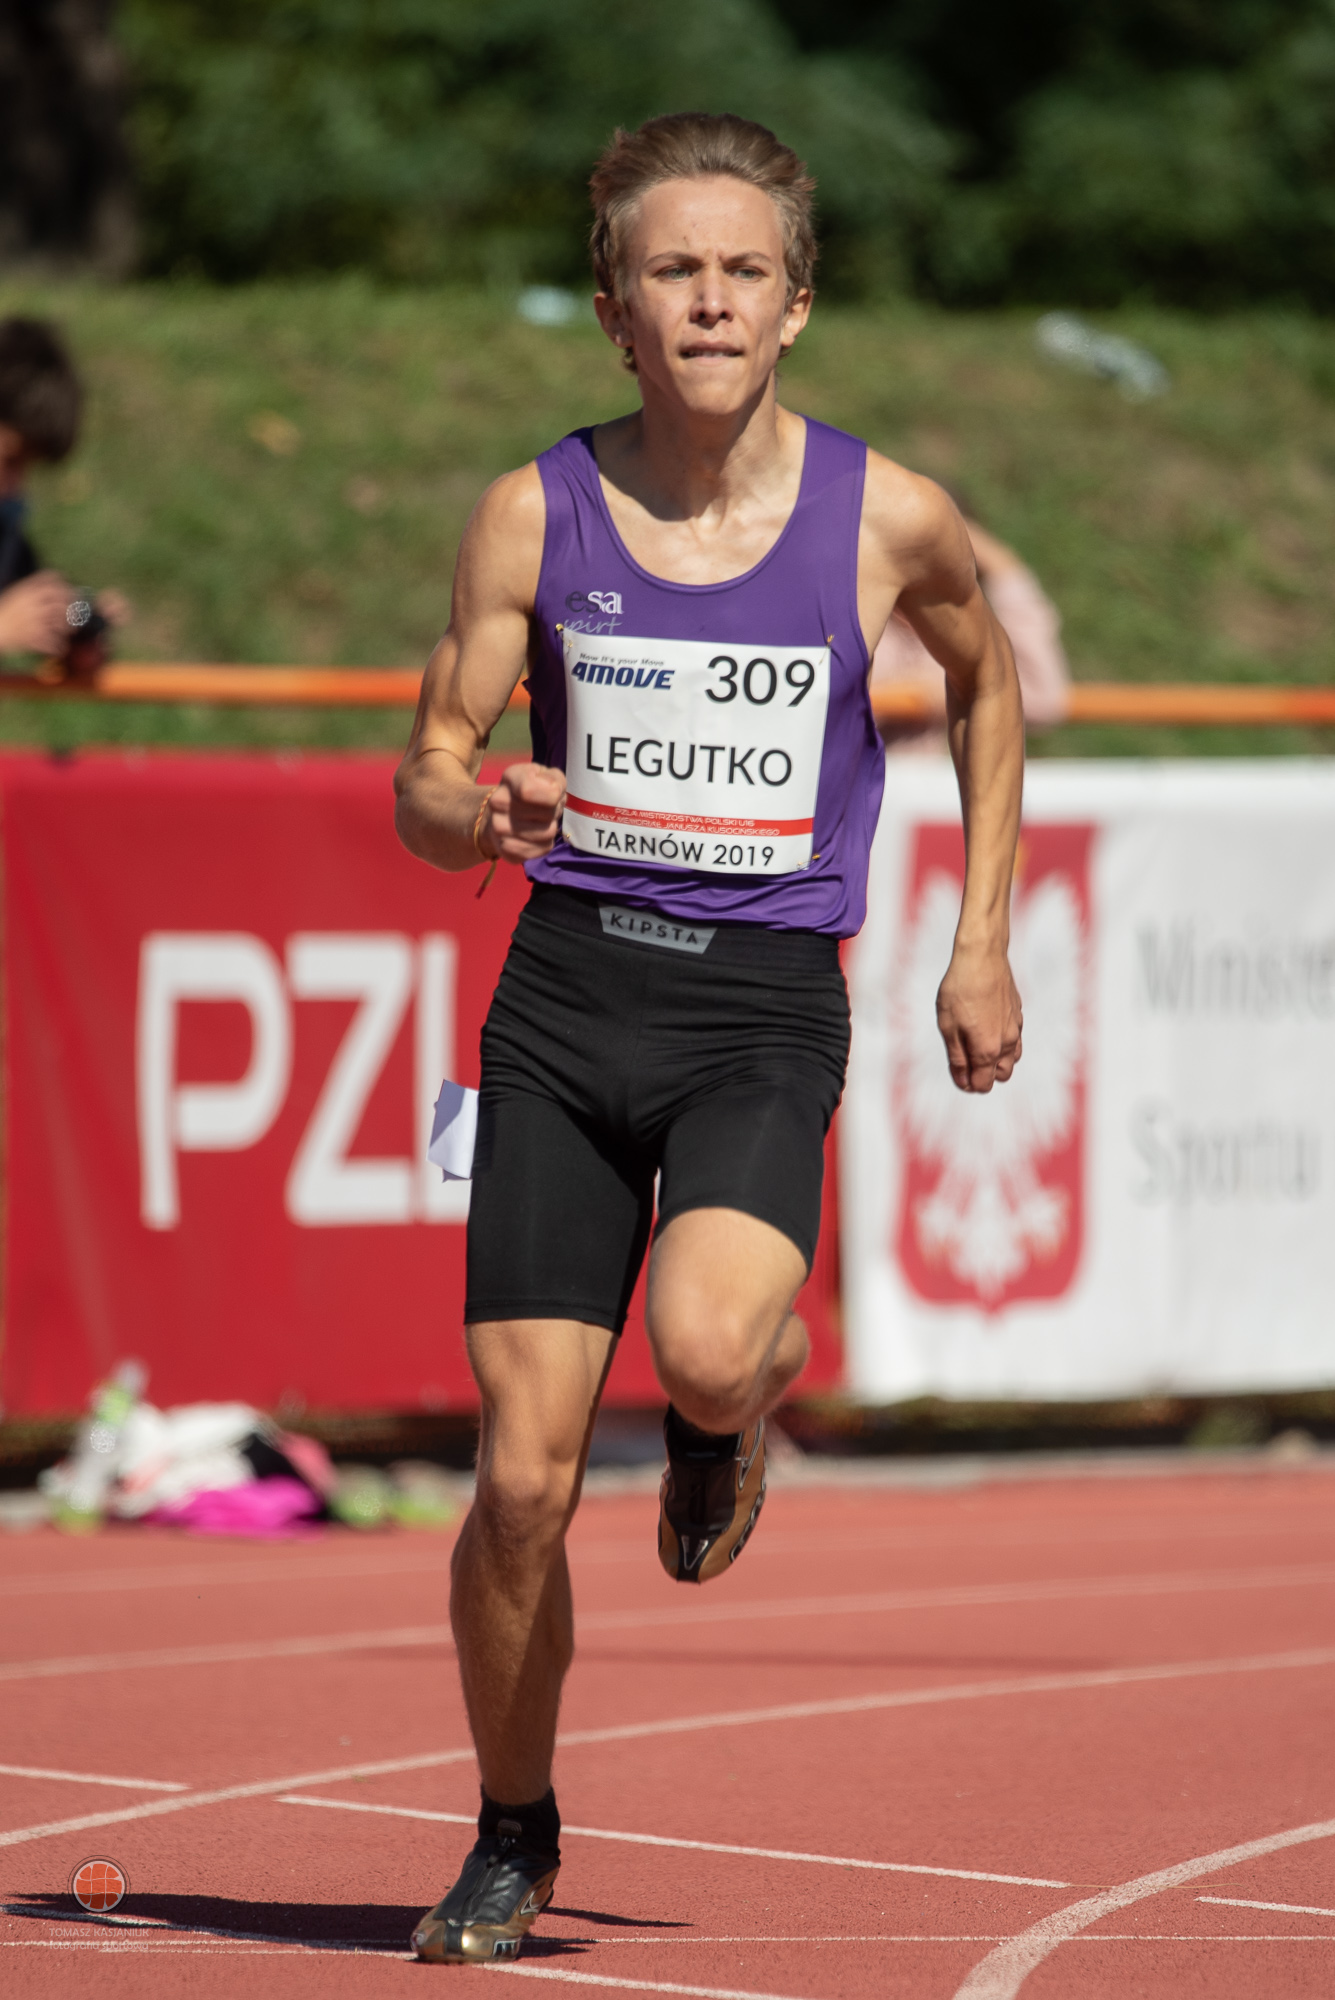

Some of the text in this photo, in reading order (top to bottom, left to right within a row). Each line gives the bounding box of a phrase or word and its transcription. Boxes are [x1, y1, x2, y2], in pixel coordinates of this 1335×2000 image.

[565, 590, 624, 615] esa
[704, 655, 816, 707] 309
[586, 733, 792, 787] LEGUTKO
[614, 807, 638, 818] PZLA
[638, 811, 703, 824] MISTRZOSTWA
[704, 817, 738, 827] POLSKI
[663, 822, 706, 833] JANUSZA
[594, 828, 775, 868] TARNÓW 2019
[610, 912, 698, 945] KIPSTA
